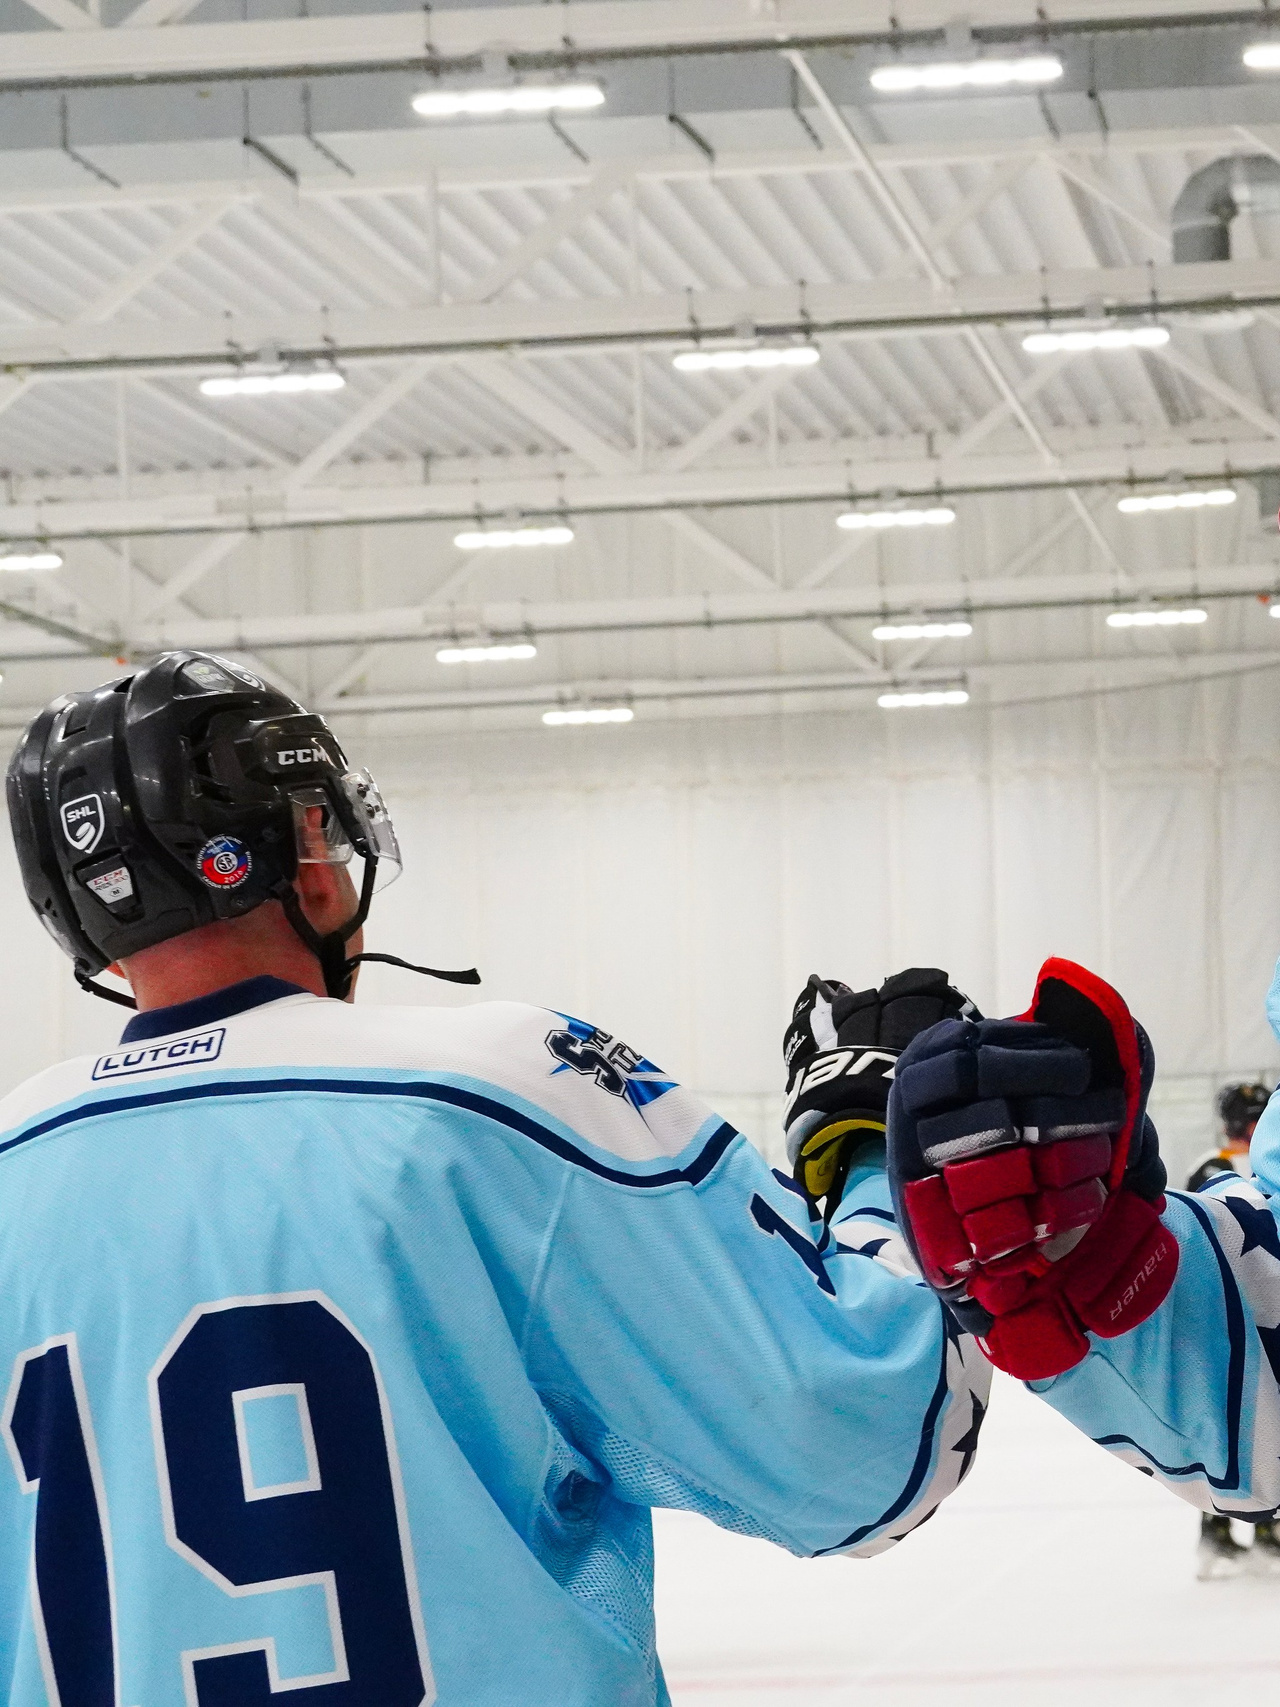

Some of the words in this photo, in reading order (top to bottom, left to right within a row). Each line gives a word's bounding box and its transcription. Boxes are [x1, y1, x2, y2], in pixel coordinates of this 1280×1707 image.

[276, 749, 328, 766] CCM
[66, 805, 97, 823] SHL
[102, 1036, 215, 1071] LUTCH
[1, 1290, 437, 1707] 19
